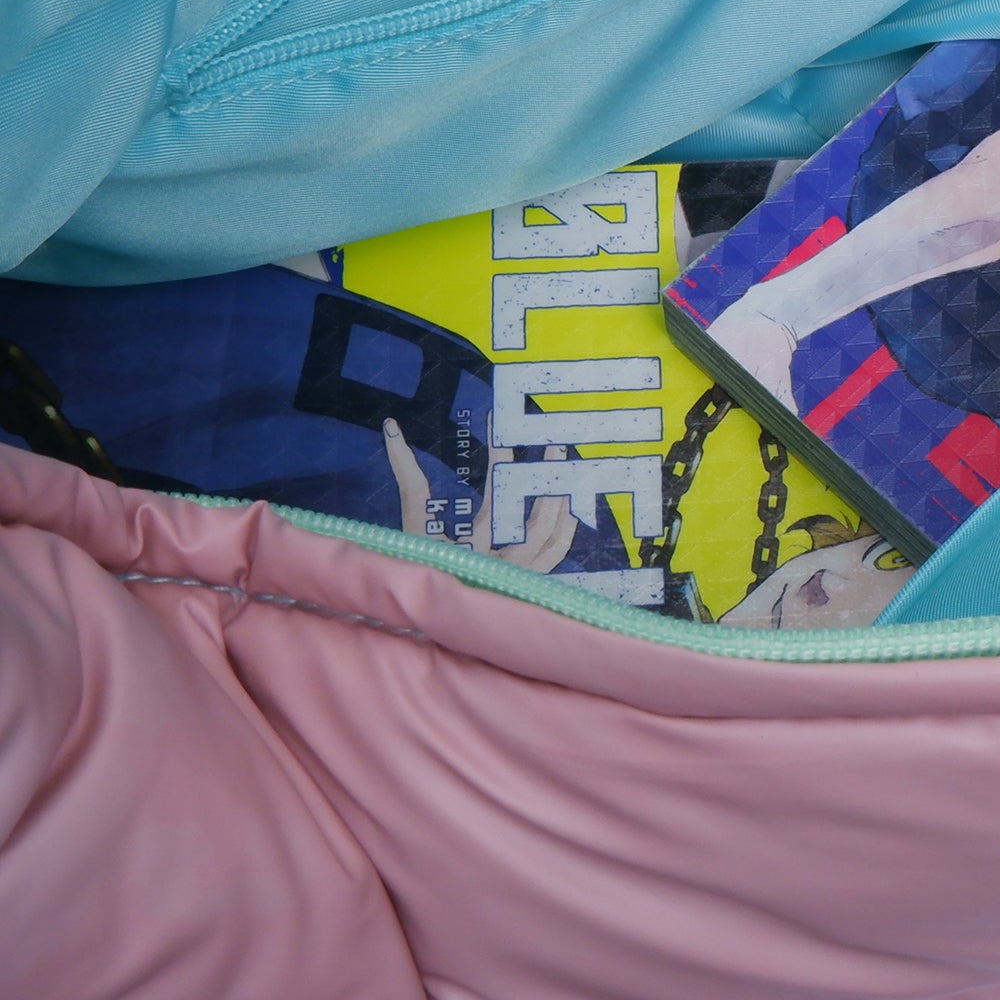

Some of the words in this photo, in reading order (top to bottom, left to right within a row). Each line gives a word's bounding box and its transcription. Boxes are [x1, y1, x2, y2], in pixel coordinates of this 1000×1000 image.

[491, 170, 664, 546] BLUE
[456, 408, 471, 459] STORY
[456, 466, 471, 486] BY
